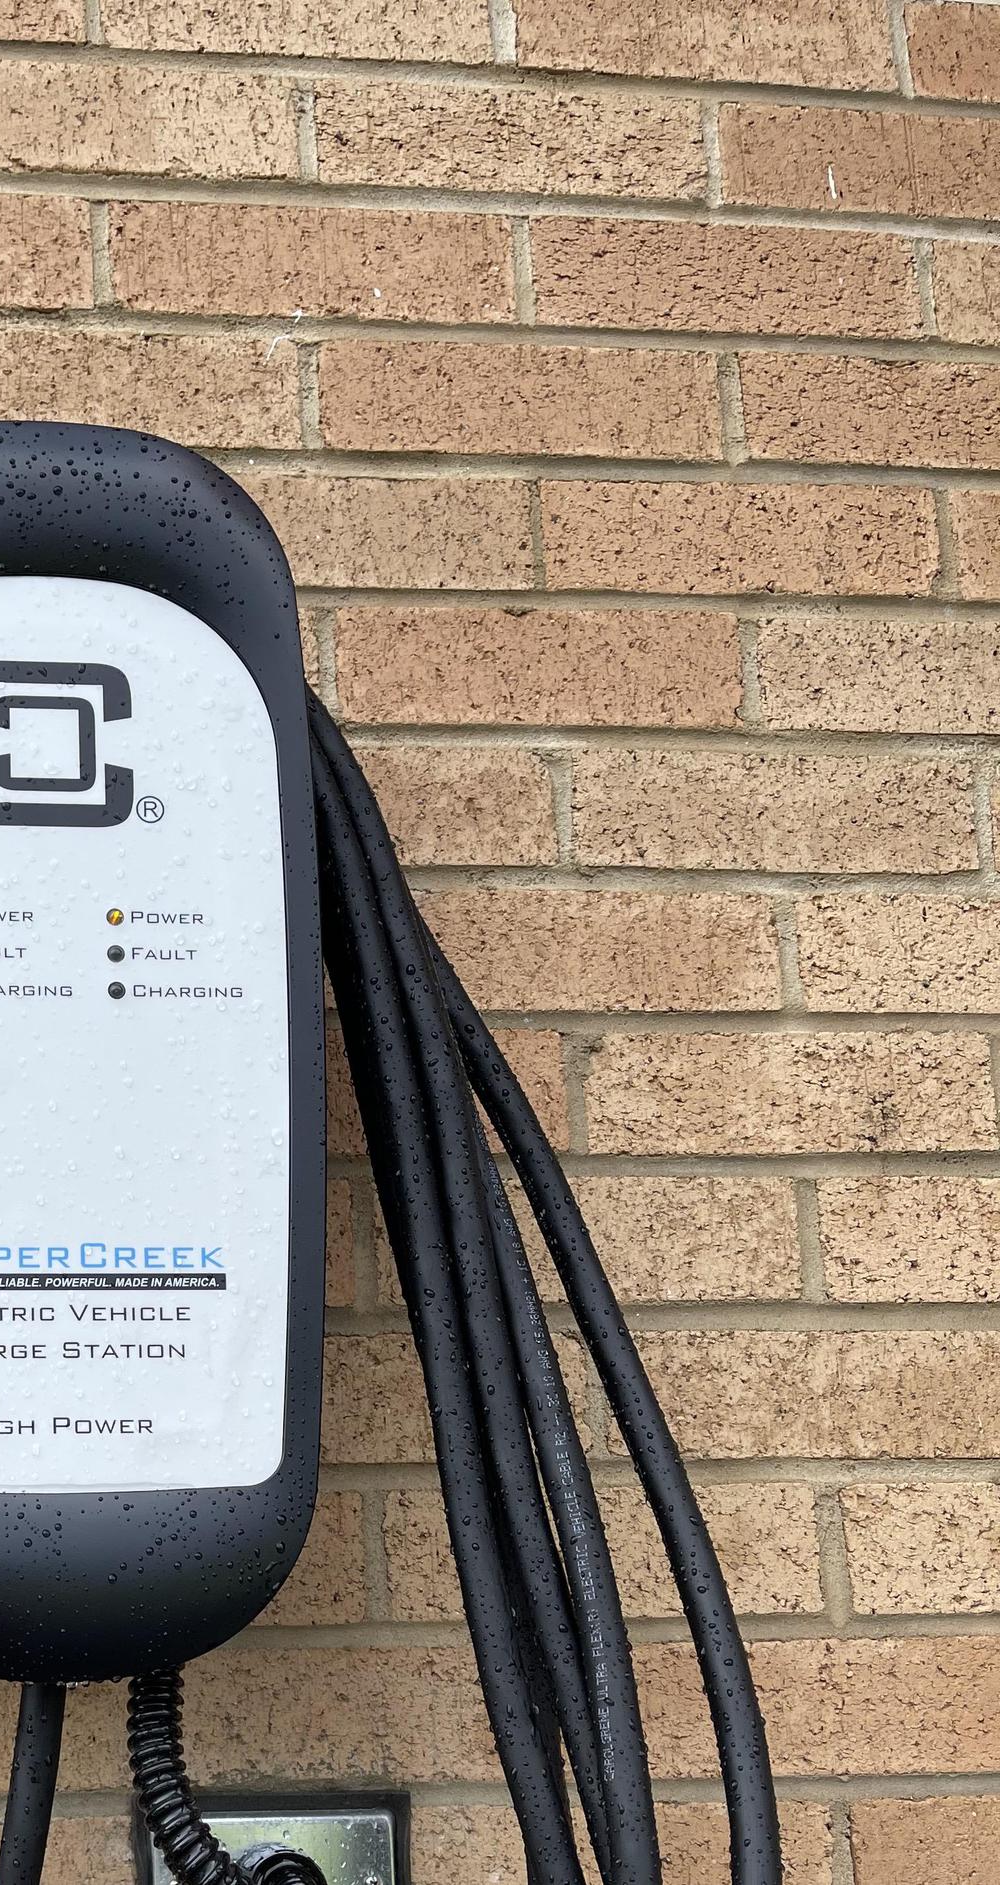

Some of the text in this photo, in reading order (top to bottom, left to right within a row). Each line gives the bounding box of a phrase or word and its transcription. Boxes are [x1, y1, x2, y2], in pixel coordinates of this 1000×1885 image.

[130, 910, 204, 924] POWER
[131, 947, 198, 961] FAULT
[133, 984, 243, 999] CHARGING
[45, 1277, 112, 1288] POWERFUL.
[115, 1277, 149, 1288] MADE
[150, 1277, 162, 1288] IN
[162, 1277, 220, 1288] AMERICA.
[69, 1304, 192, 1322] VEHICLE
[63, 1341, 186, 1359] STATION
[537, 1349, 552, 1370] AWG
[52, 1417, 154, 1434] POWER
[556, 1451, 574, 1486] CABLE
[565, 1491, 586, 1539] VEHICLE
[576, 1544, 596, 1601] ELECTRIC
[595, 1662, 609, 1701] ULTRA
